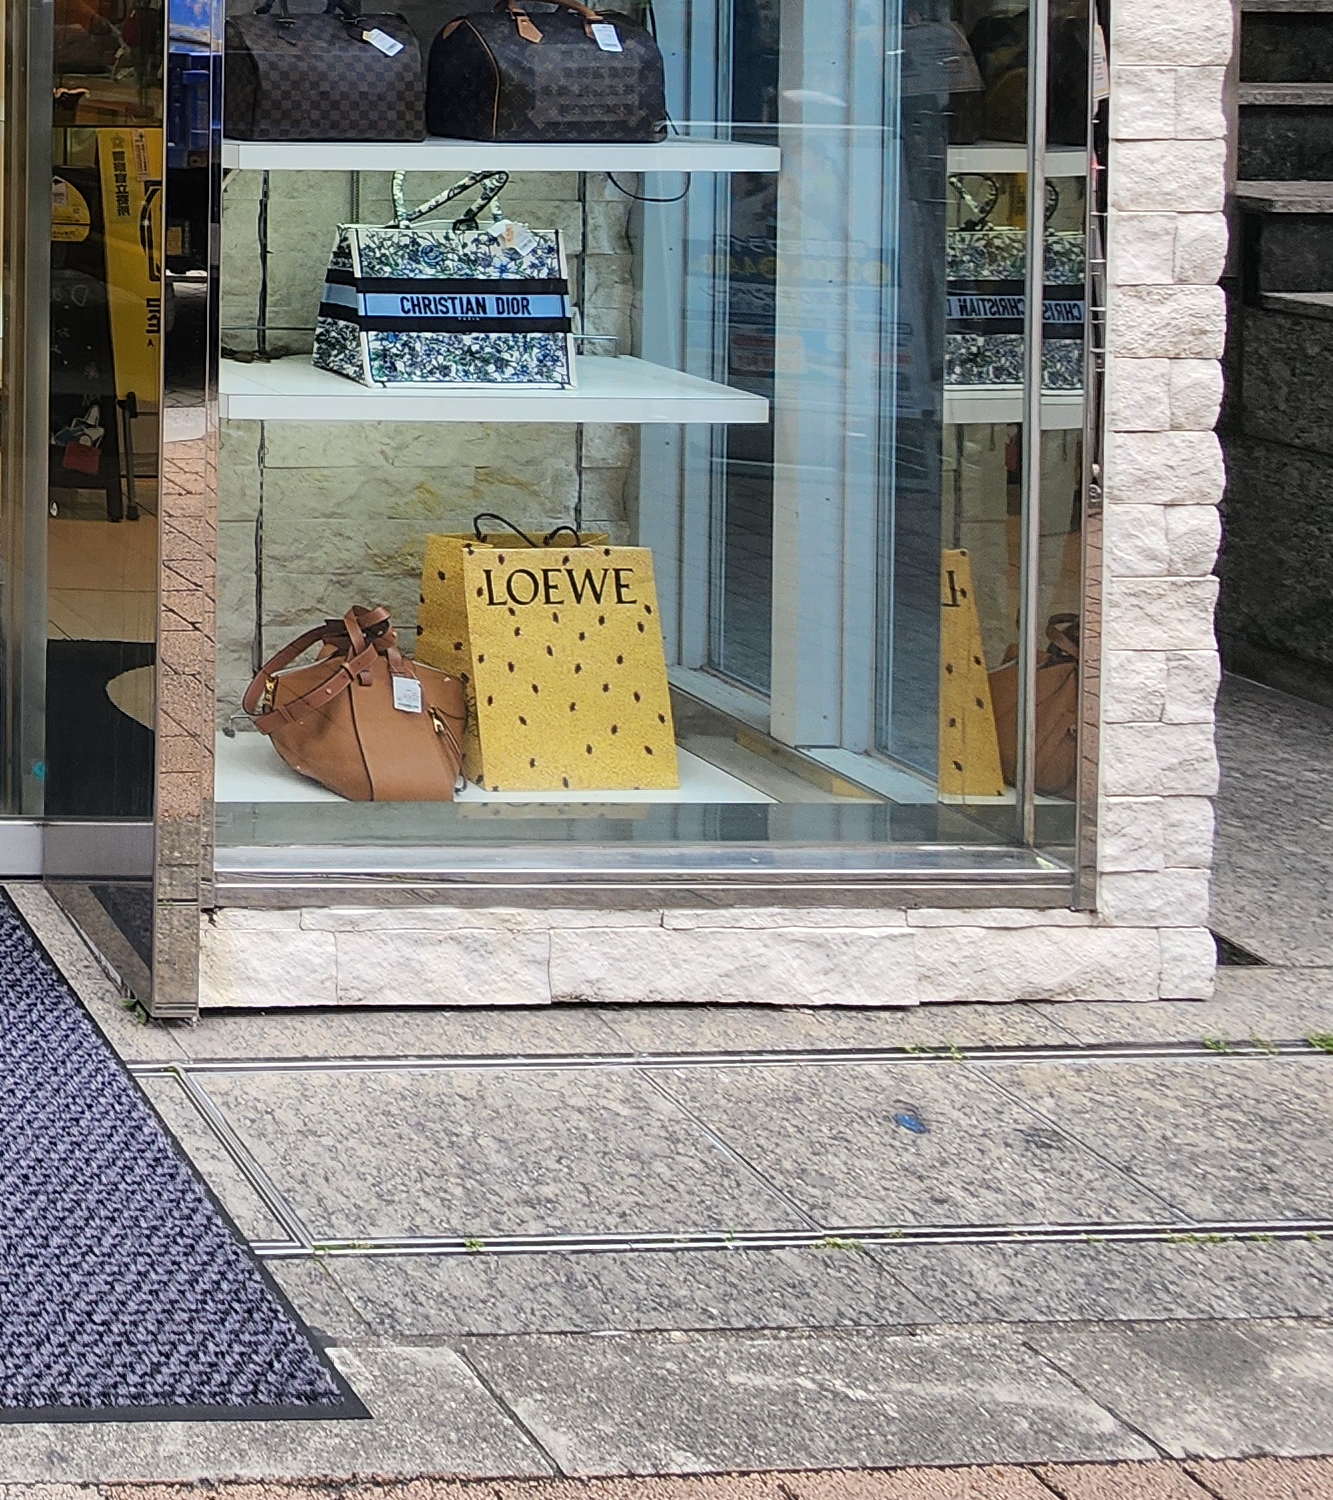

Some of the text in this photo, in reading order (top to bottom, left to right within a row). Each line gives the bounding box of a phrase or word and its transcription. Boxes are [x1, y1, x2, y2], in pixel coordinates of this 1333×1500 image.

[399, 296, 532, 316] CHRISTIAN DIOR
[483, 567, 638, 607] LOEWE
